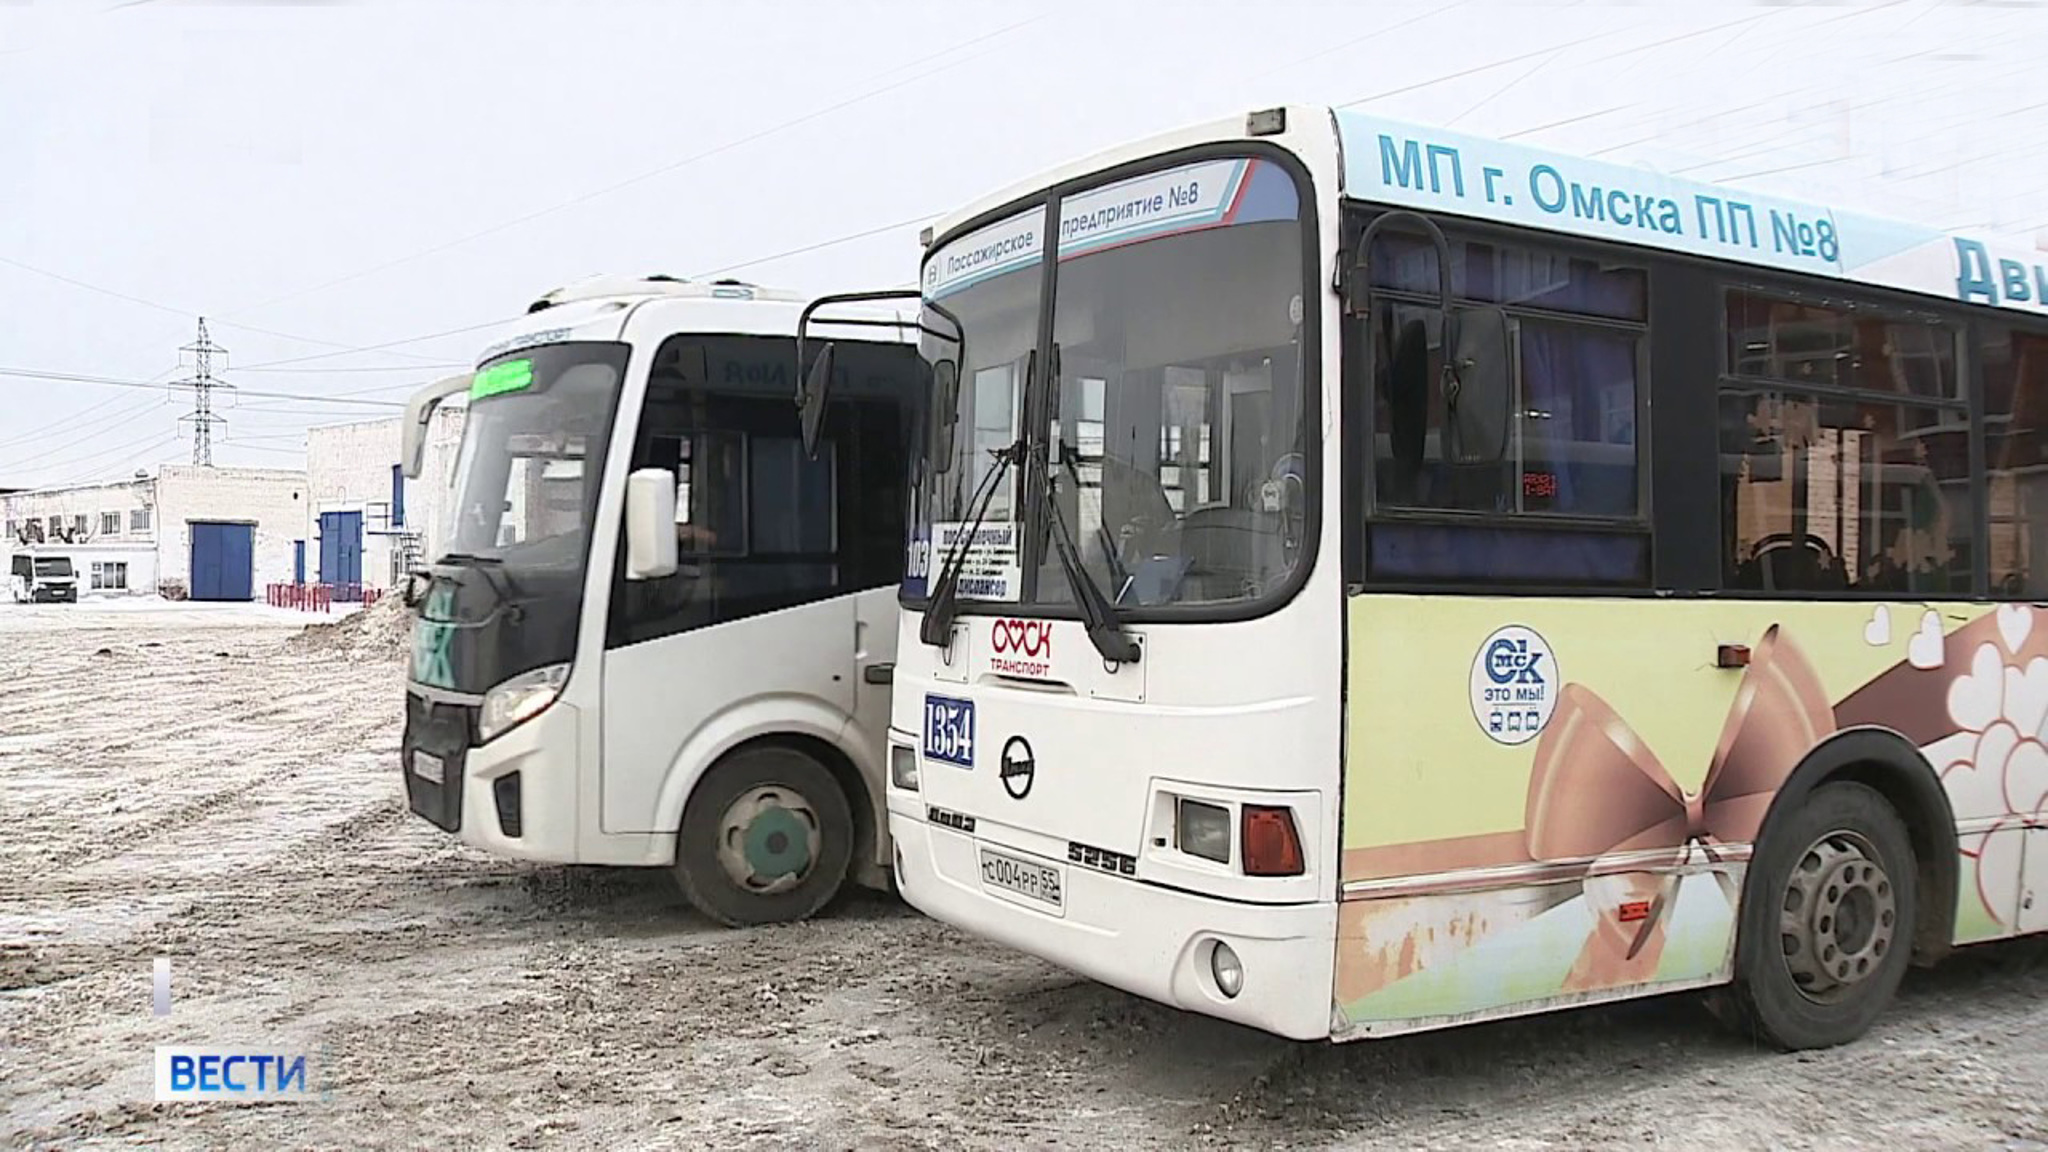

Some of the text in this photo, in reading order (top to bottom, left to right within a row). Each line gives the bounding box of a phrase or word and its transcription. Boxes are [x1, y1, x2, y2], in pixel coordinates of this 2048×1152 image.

[1378, 134, 1838, 262] МП г. Омска ПП №8
[946, 181, 1199, 275] Пассажирское предприятие №8
[907, 540, 930, 578] 103
[991, 658, 1050, 677] ТРАНСПОРТ
[1485, 685, 1544, 701] ЭТО МЫ!
[927, 703, 972, 760] 1354
[1068, 841, 1136, 875] 5256
